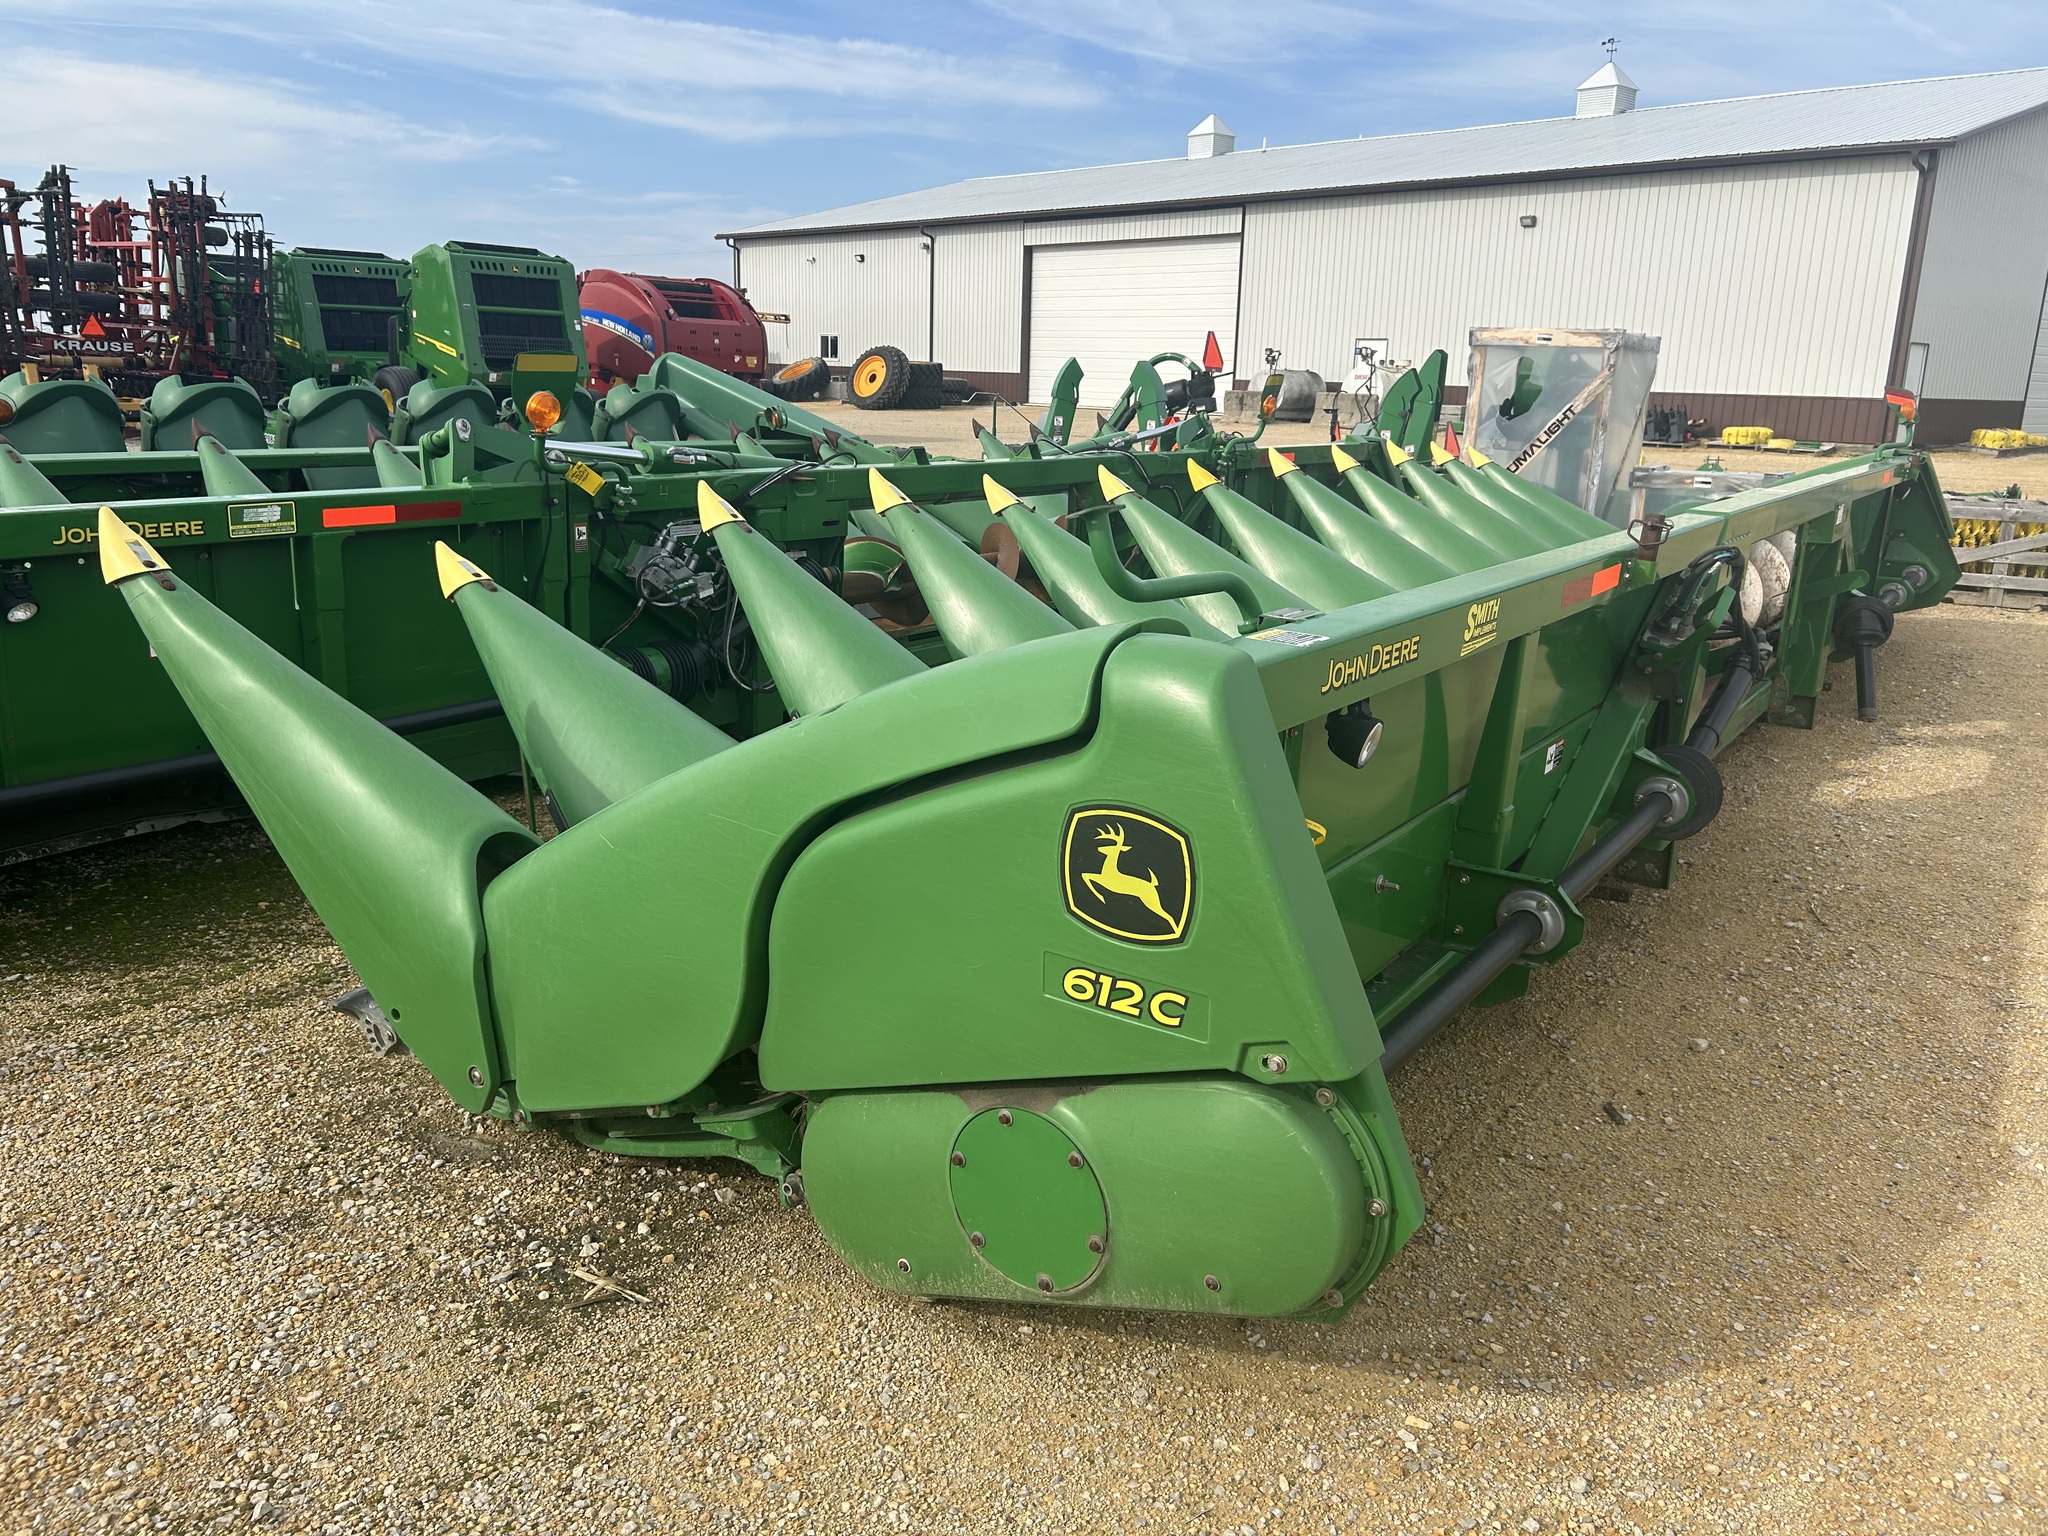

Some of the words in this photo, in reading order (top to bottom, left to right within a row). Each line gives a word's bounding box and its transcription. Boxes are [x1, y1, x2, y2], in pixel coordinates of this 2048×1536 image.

[53, 340, 134, 352] KRAUSE
[602, 318, 615, 329] NEW
[615, 323, 641, 343] HOLLAND
[52, 525, 100, 545] JOH
[124, 520, 205, 538] DEERE
[1464, 598, 1501, 642] SMITH
[1321, 653, 1369, 694] JOHN
[1369, 635, 1420, 675] DEERE
[1063, 967, 1188, 1027] 612C
